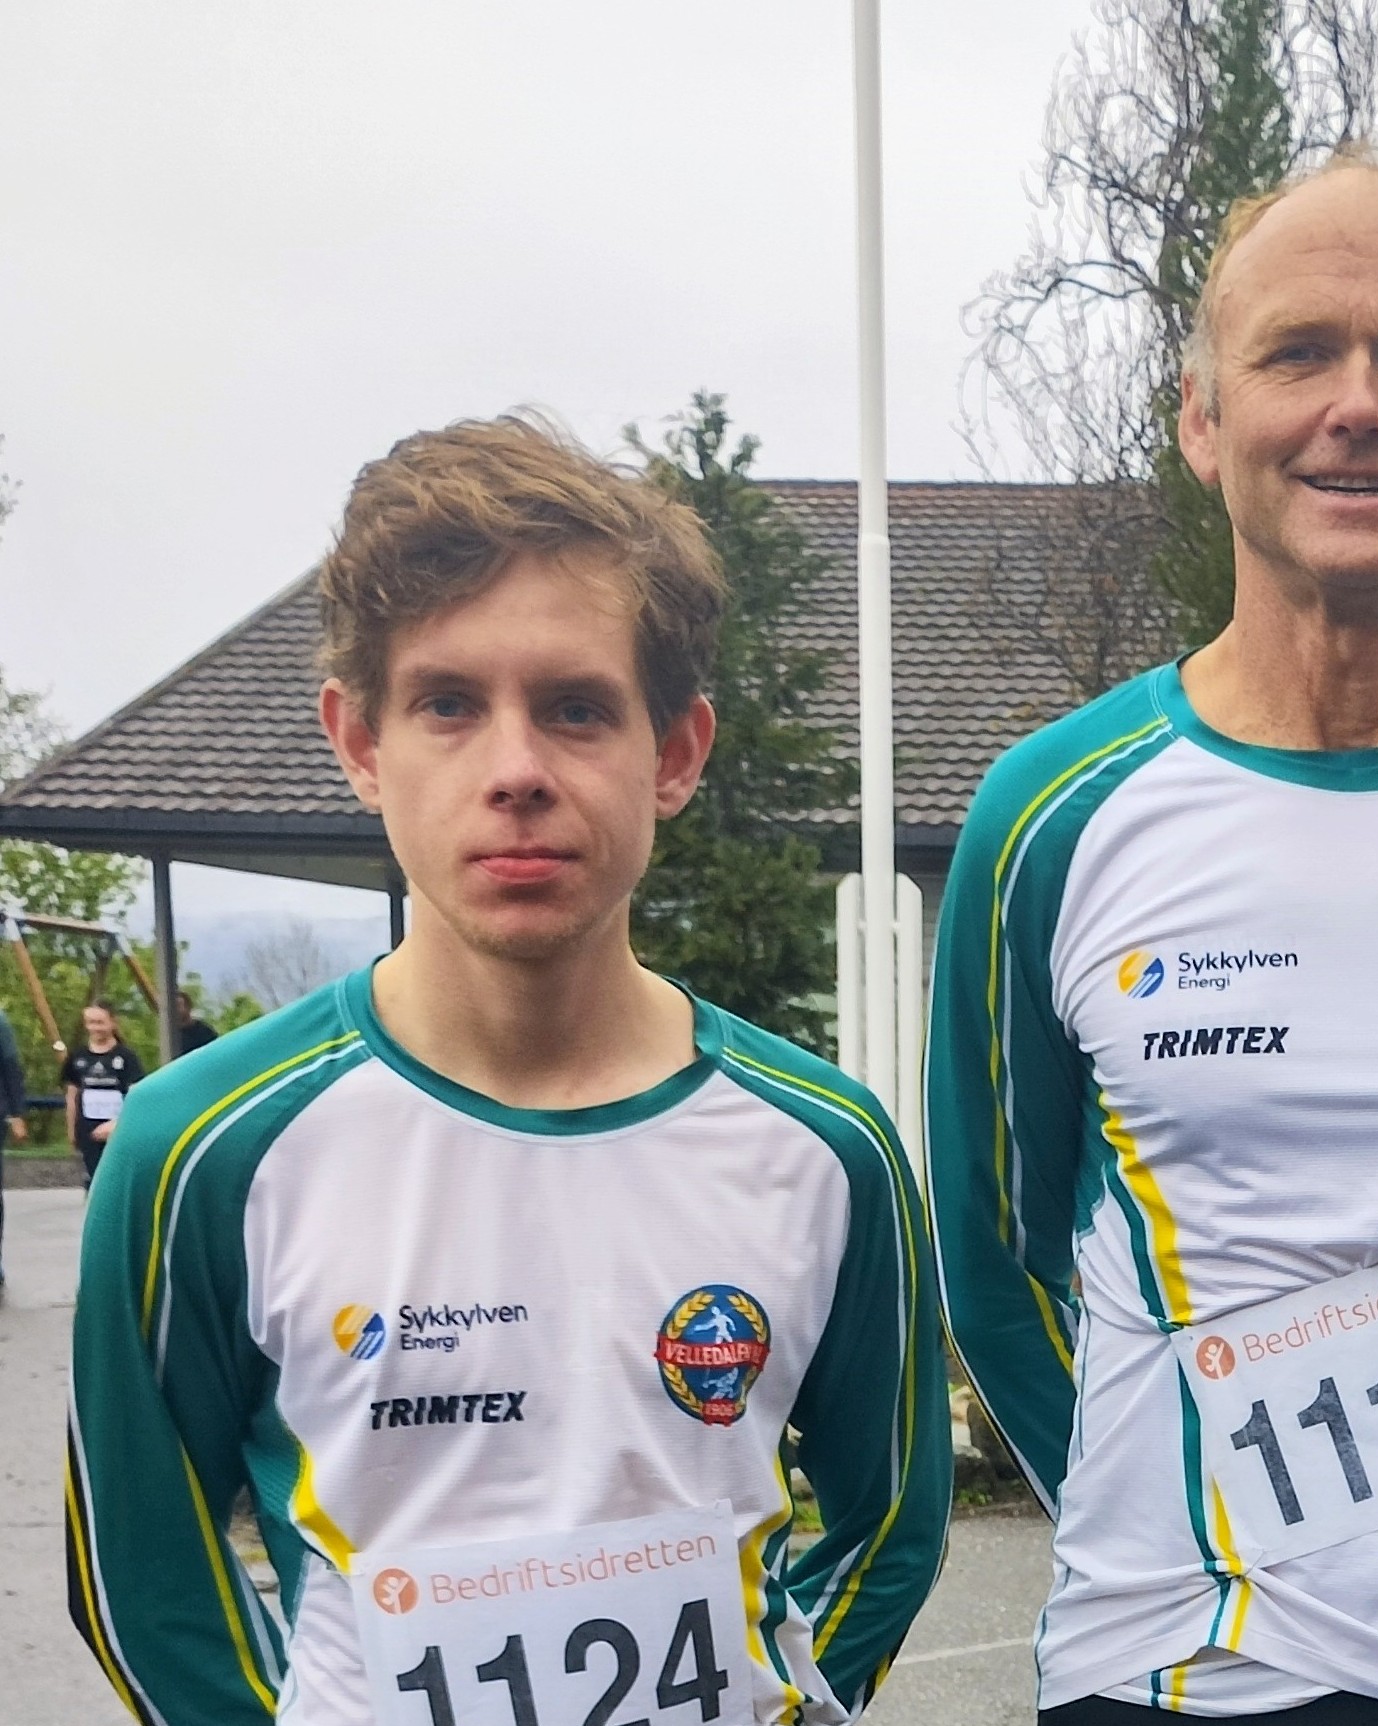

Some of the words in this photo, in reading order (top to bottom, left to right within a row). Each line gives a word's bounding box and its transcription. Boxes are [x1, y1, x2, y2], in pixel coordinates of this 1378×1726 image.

[1178, 949, 1299, 973] Sykkylven
[1178, 974, 1231, 991] Energi
[1143, 1026, 1290, 1061] TRIMTEX
[399, 1303, 529, 1332] Sykkylven
[400, 1333, 460, 1352] Energi
[370, 1391, 527, 1430] TRIMTEX
[431, 1534, 717, 1605] Bedriftsidretten
